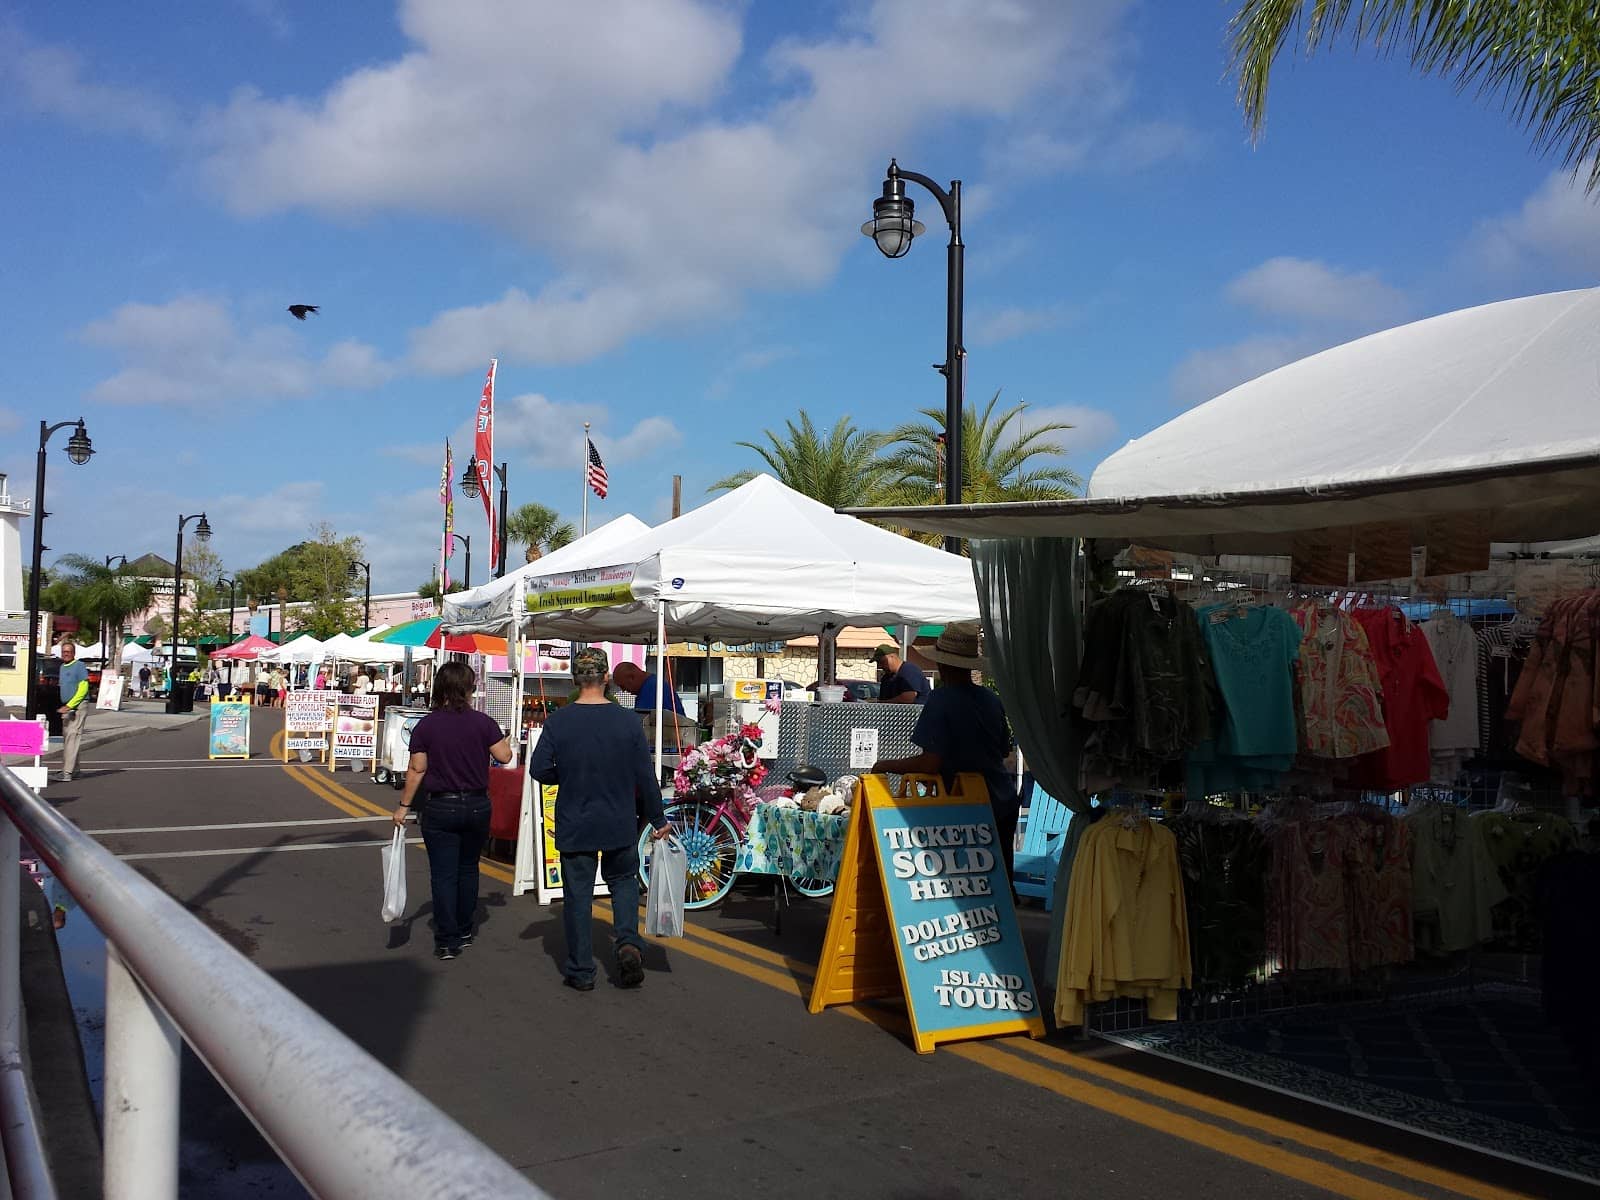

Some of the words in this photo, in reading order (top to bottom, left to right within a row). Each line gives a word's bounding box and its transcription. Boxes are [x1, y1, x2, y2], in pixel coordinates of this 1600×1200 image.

[411, 601, 432, 611] Belgian
[539, 594, 555, 608] Fresh
[556, 593, 583, 608] Squeezed
[584, 588, 617, 604] Lemonade
[287, 693, 325, 702] COFFEE
[362, 696, 377, 705] FLOAT
[299, 704, 325, 712] CHOCOLATE
[337, 735, 373, 744] WATER
[334, 748, 361, 756] SHAVED
[883, 823, 993, 850] TICKETS
[892, 847, 995, 878] SOLD
[907, 875, 992, 901] HERE
[901, 904, 1000, 945] DOLPHIN
[913, 926, 1001, 961] CRUISES
[940, 969, 1023, 990] ISLAND
[933, 985, 1034, 1012] TOURS
